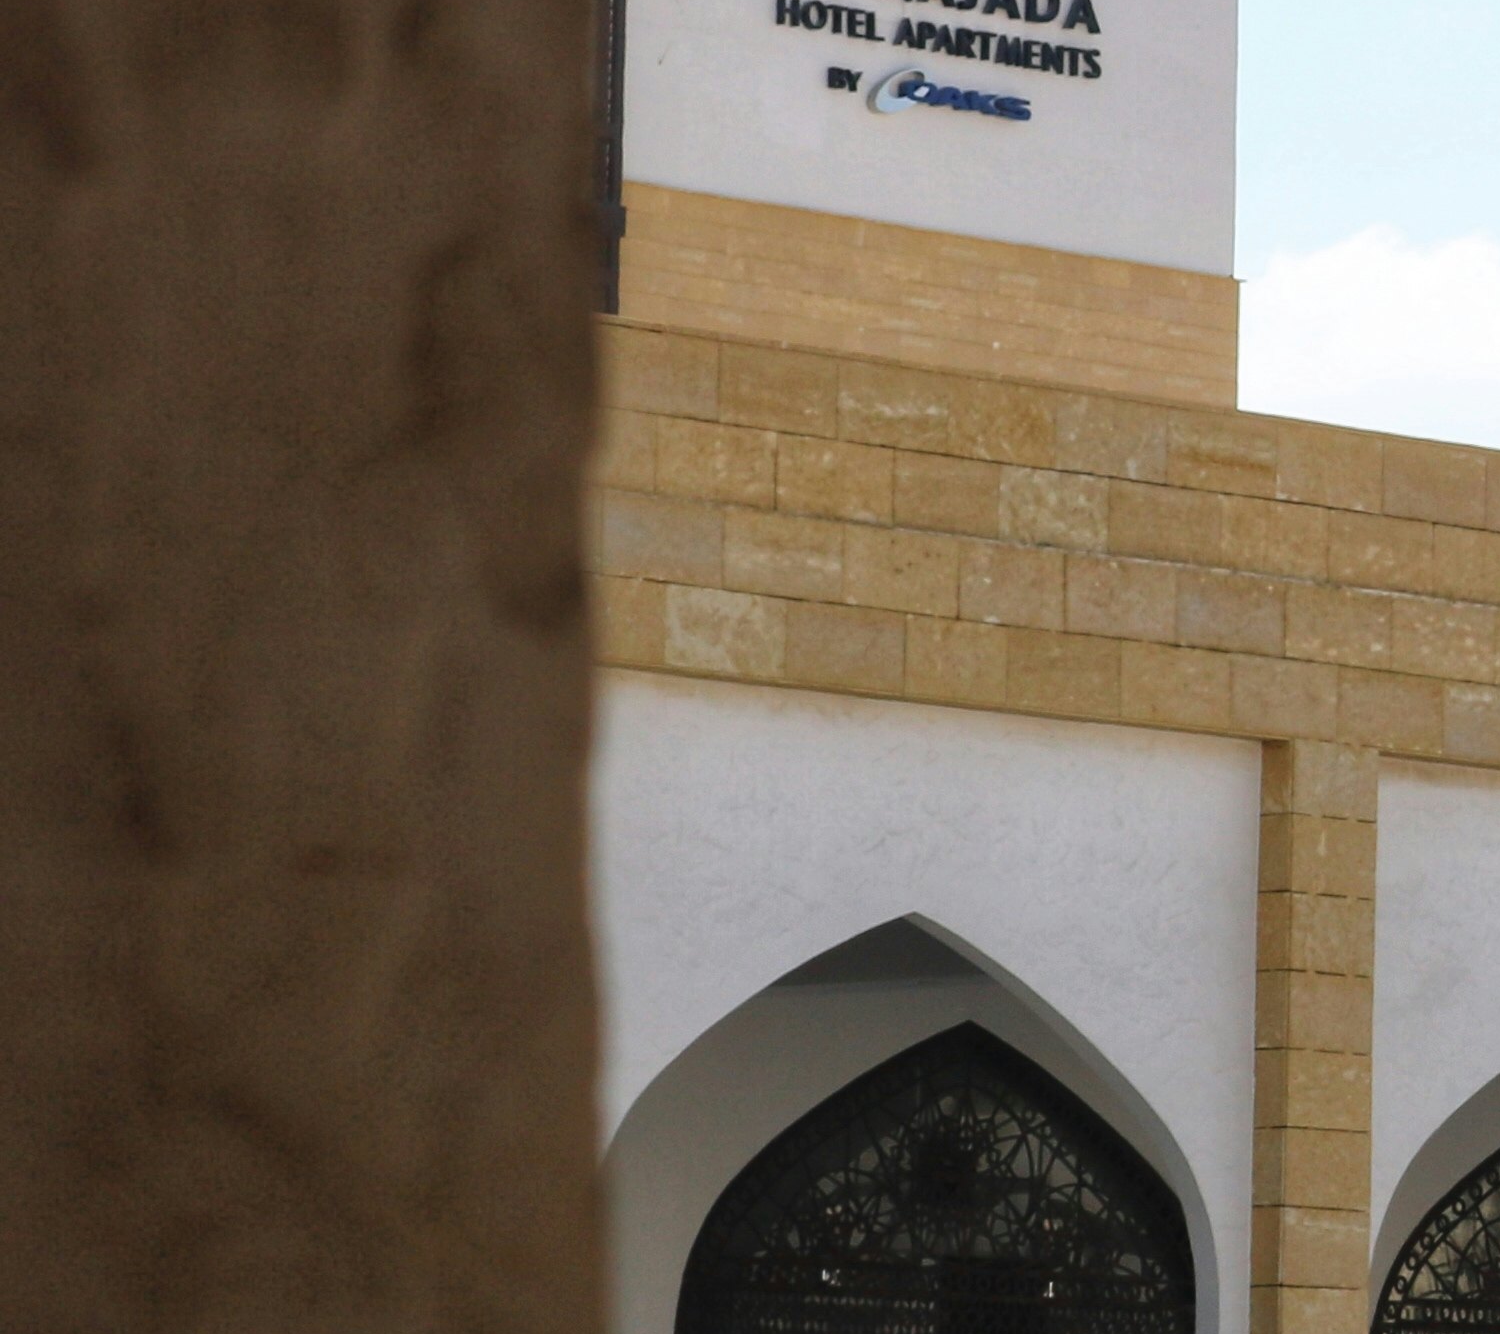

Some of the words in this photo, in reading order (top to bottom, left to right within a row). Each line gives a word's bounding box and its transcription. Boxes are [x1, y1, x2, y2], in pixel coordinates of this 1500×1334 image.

[892, 17, 1103, 80] APARTMENTS
[827, 66, 863, 93] BY
[899, 79, 1032, 122] OAKS
